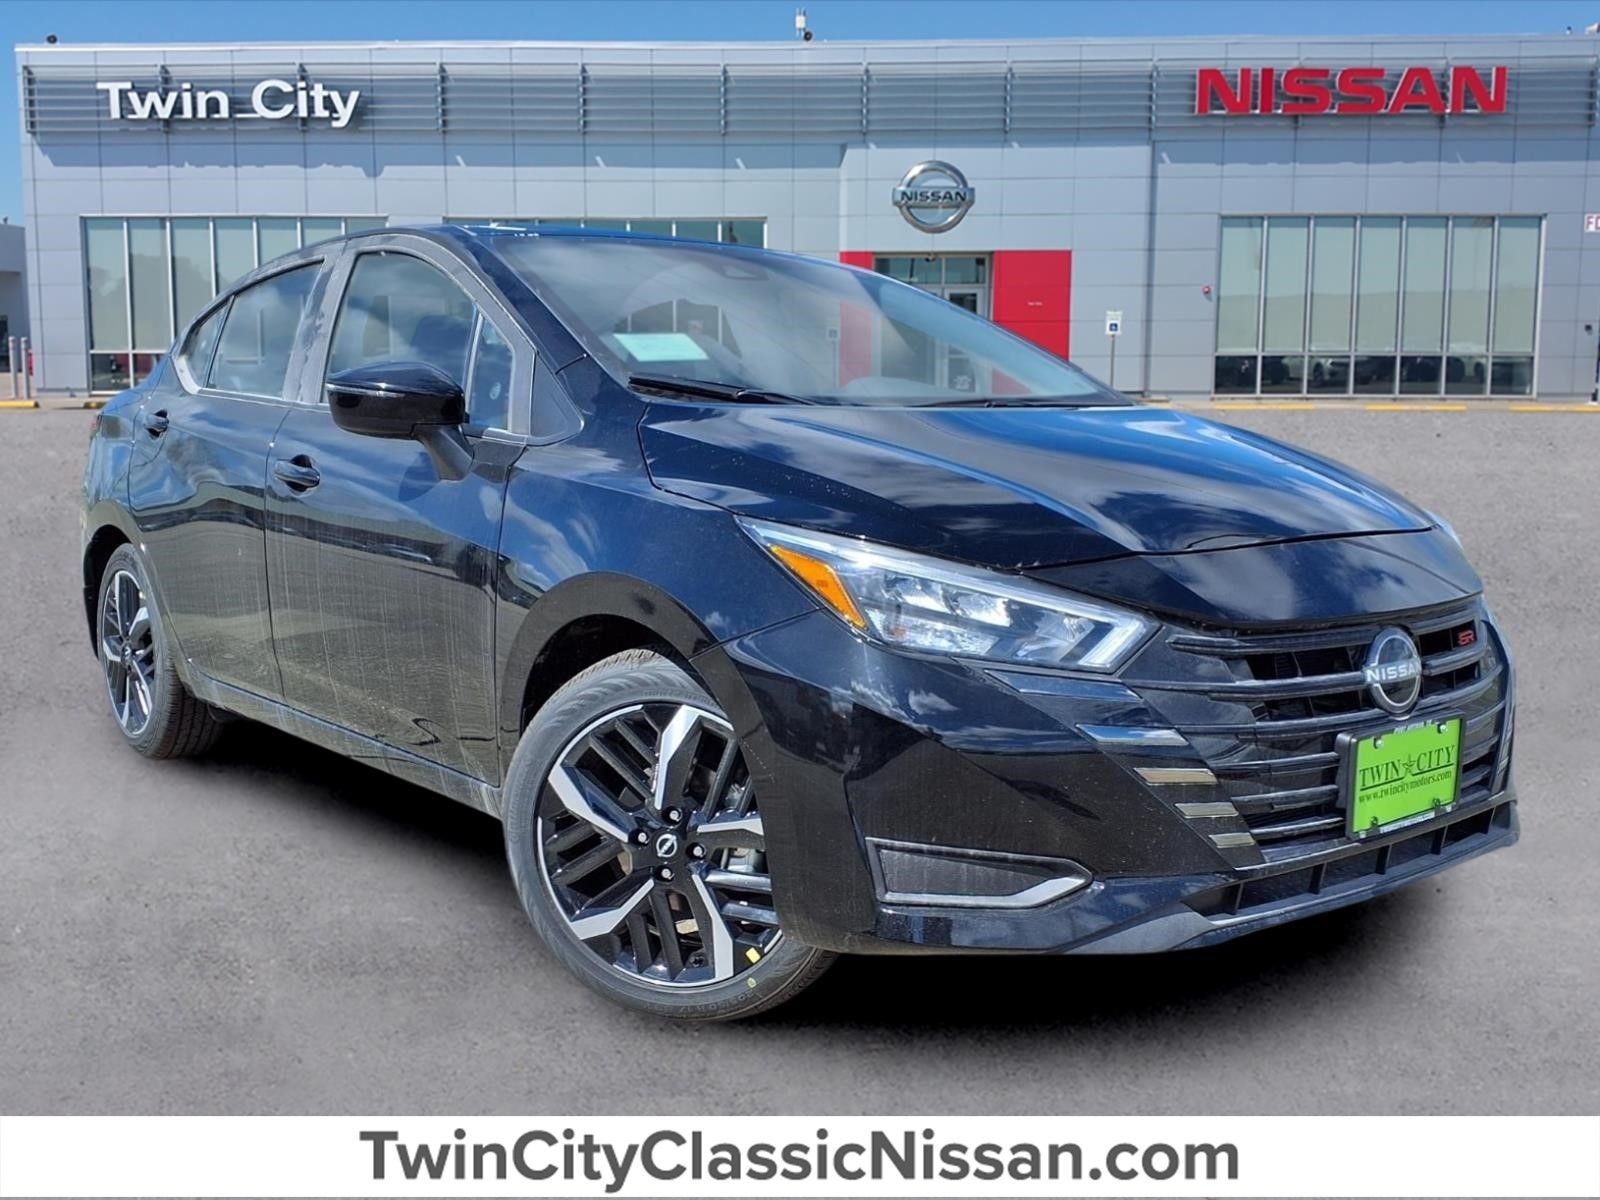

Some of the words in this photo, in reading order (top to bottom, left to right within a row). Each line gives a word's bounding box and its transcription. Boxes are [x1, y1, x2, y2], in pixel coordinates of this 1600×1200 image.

[96, 81, 229, 119] Twin
[251, 79, 360, 128] City
[1195, 66, 1509, 116] NISSAN
[900, 190, 967, 202] NISSAN
[1359, 770, 1452, 803] www.twincitymotors.com
[1360, 759, 1401, 788] TWIN
[1416, 745, 1455, 771] CITY
